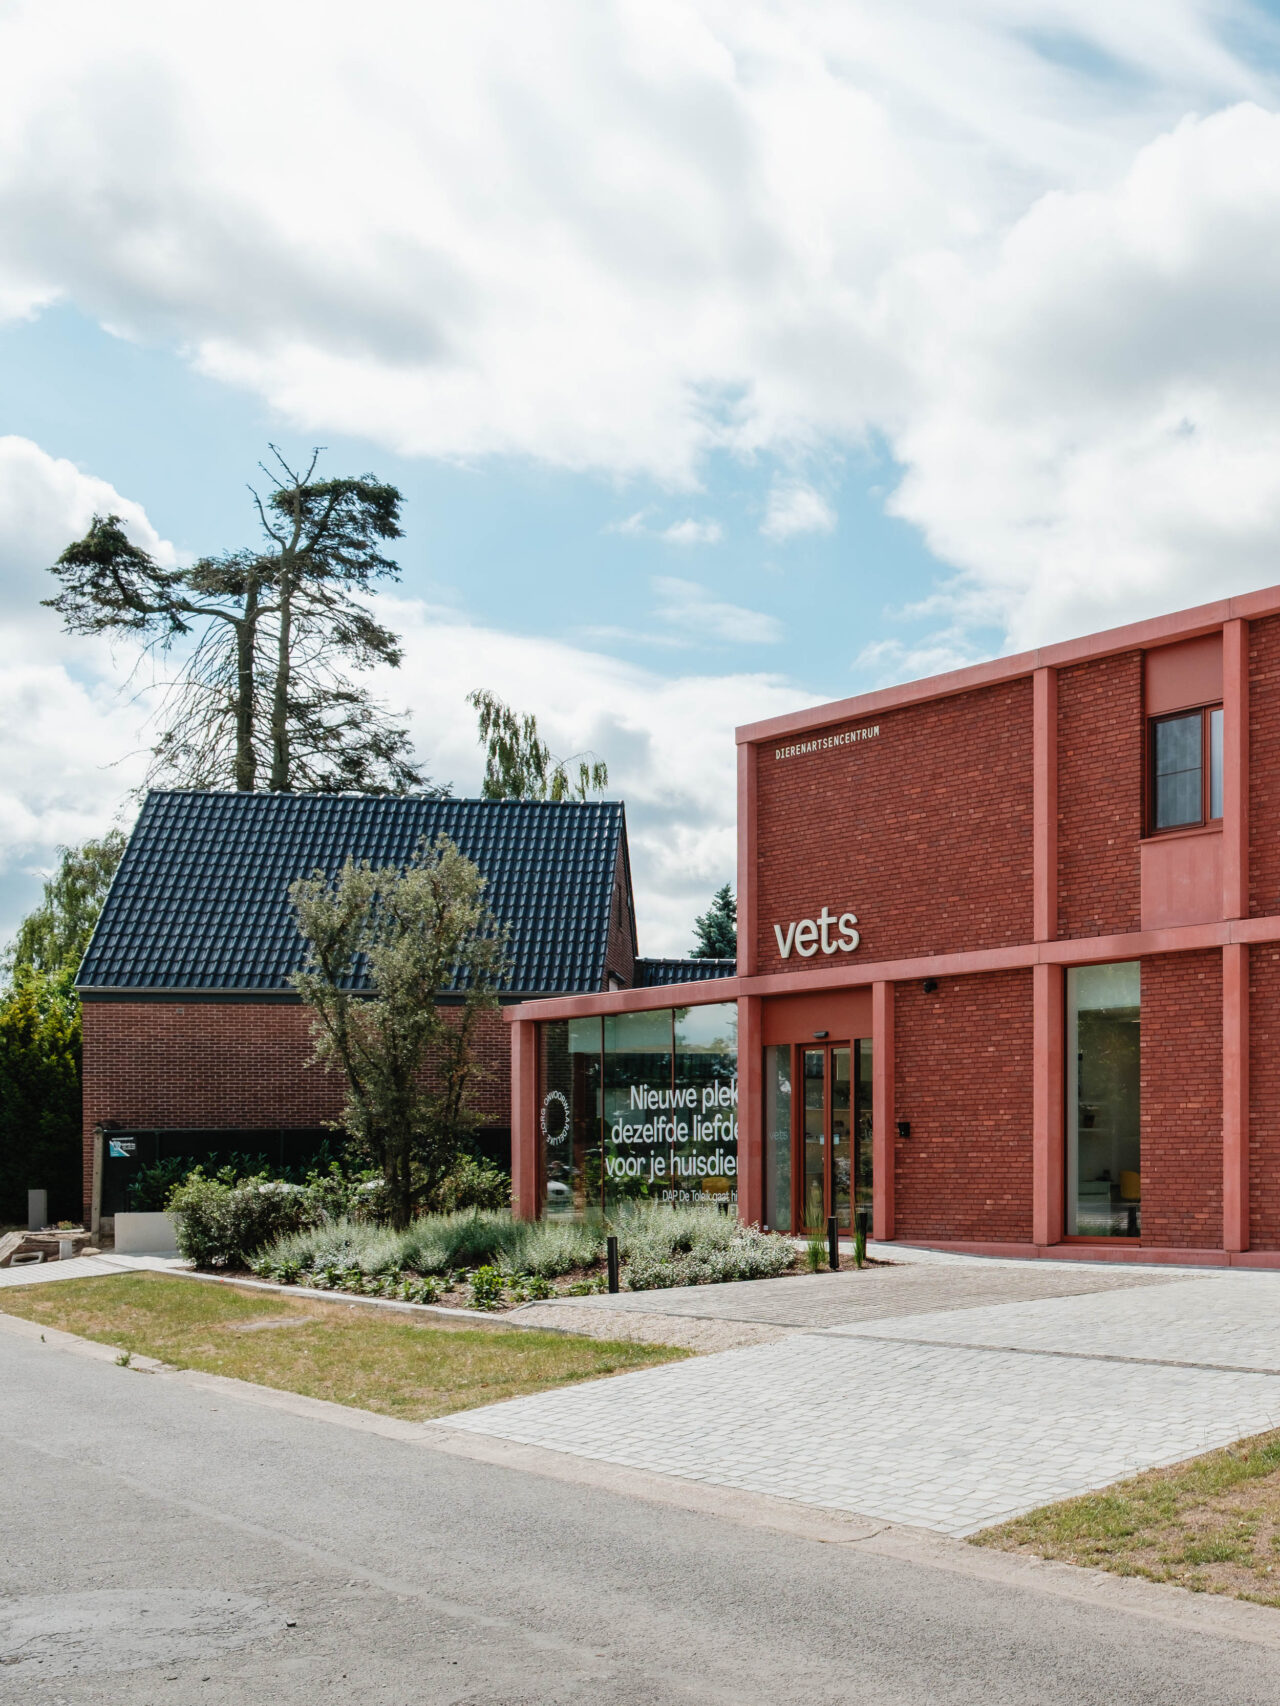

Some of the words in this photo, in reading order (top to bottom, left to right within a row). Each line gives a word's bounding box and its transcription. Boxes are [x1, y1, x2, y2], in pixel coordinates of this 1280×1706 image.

[775, 725, 880, 760] DIERENARTSENCENTRUM
[773, 906, 860, 959] vets
[630, 1083, 697, 1110] Nieuwe
[702, 1078, 738, 1114] plek
[611, 1115, 689, 1143] dezelfde
[605, 1156, 646, 1176] voor
[648, 1149, 666, 1184] je
[670, 1148, 738, 1176] huisdie
[662, 1189, 679, 1202] DAP
[679, 1189, 690, 1202] De
